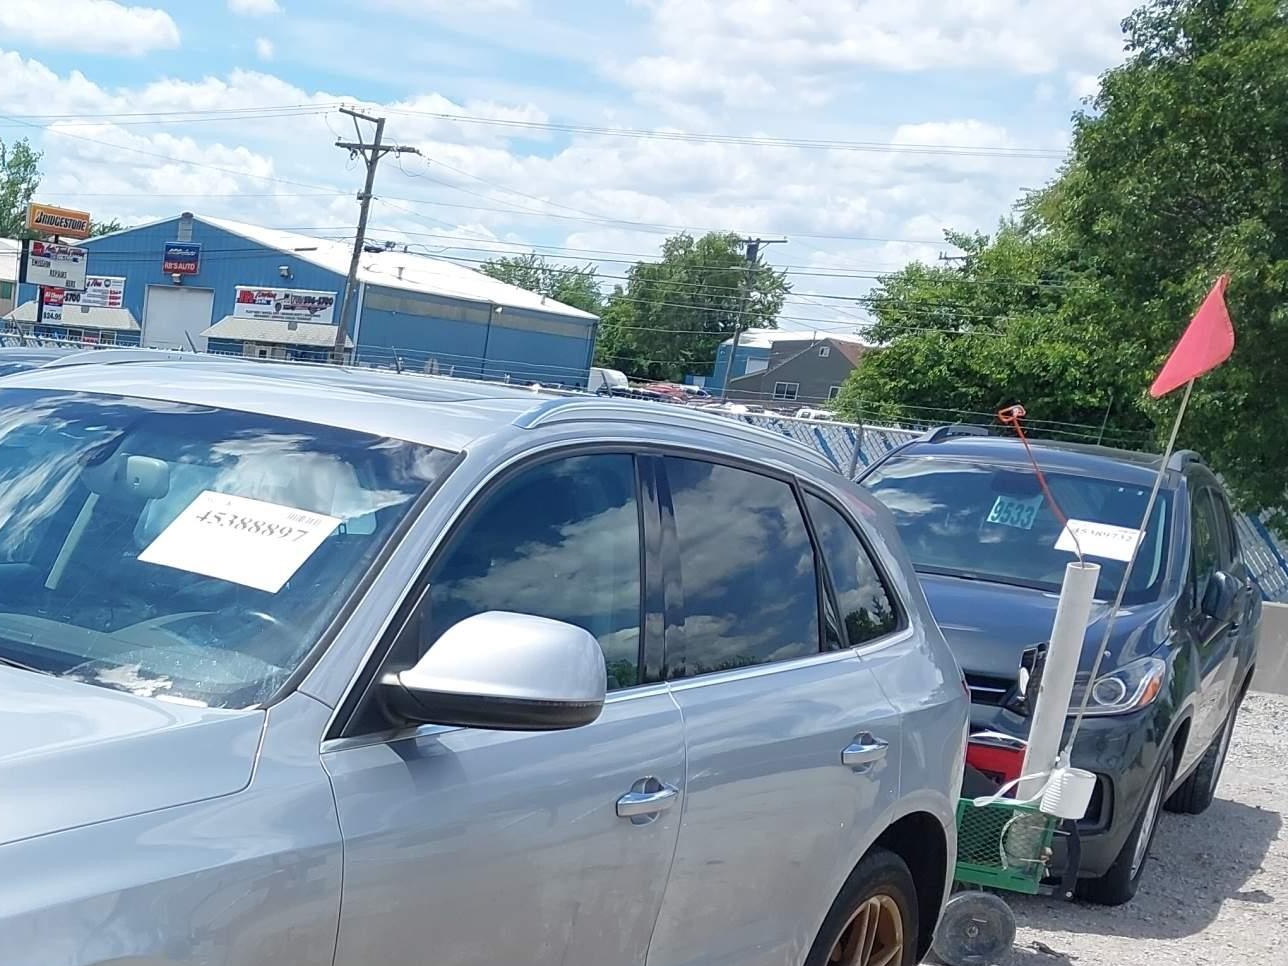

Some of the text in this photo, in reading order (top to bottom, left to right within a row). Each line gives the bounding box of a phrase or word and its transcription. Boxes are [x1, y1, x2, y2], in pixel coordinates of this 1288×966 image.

[35, 211, 87, 231] BRIDGESTONE
[178, 262, 196, 271] AUTO
[991, 501, 1035, 527] 9533
[196, 510, 310, 542] 45388897
